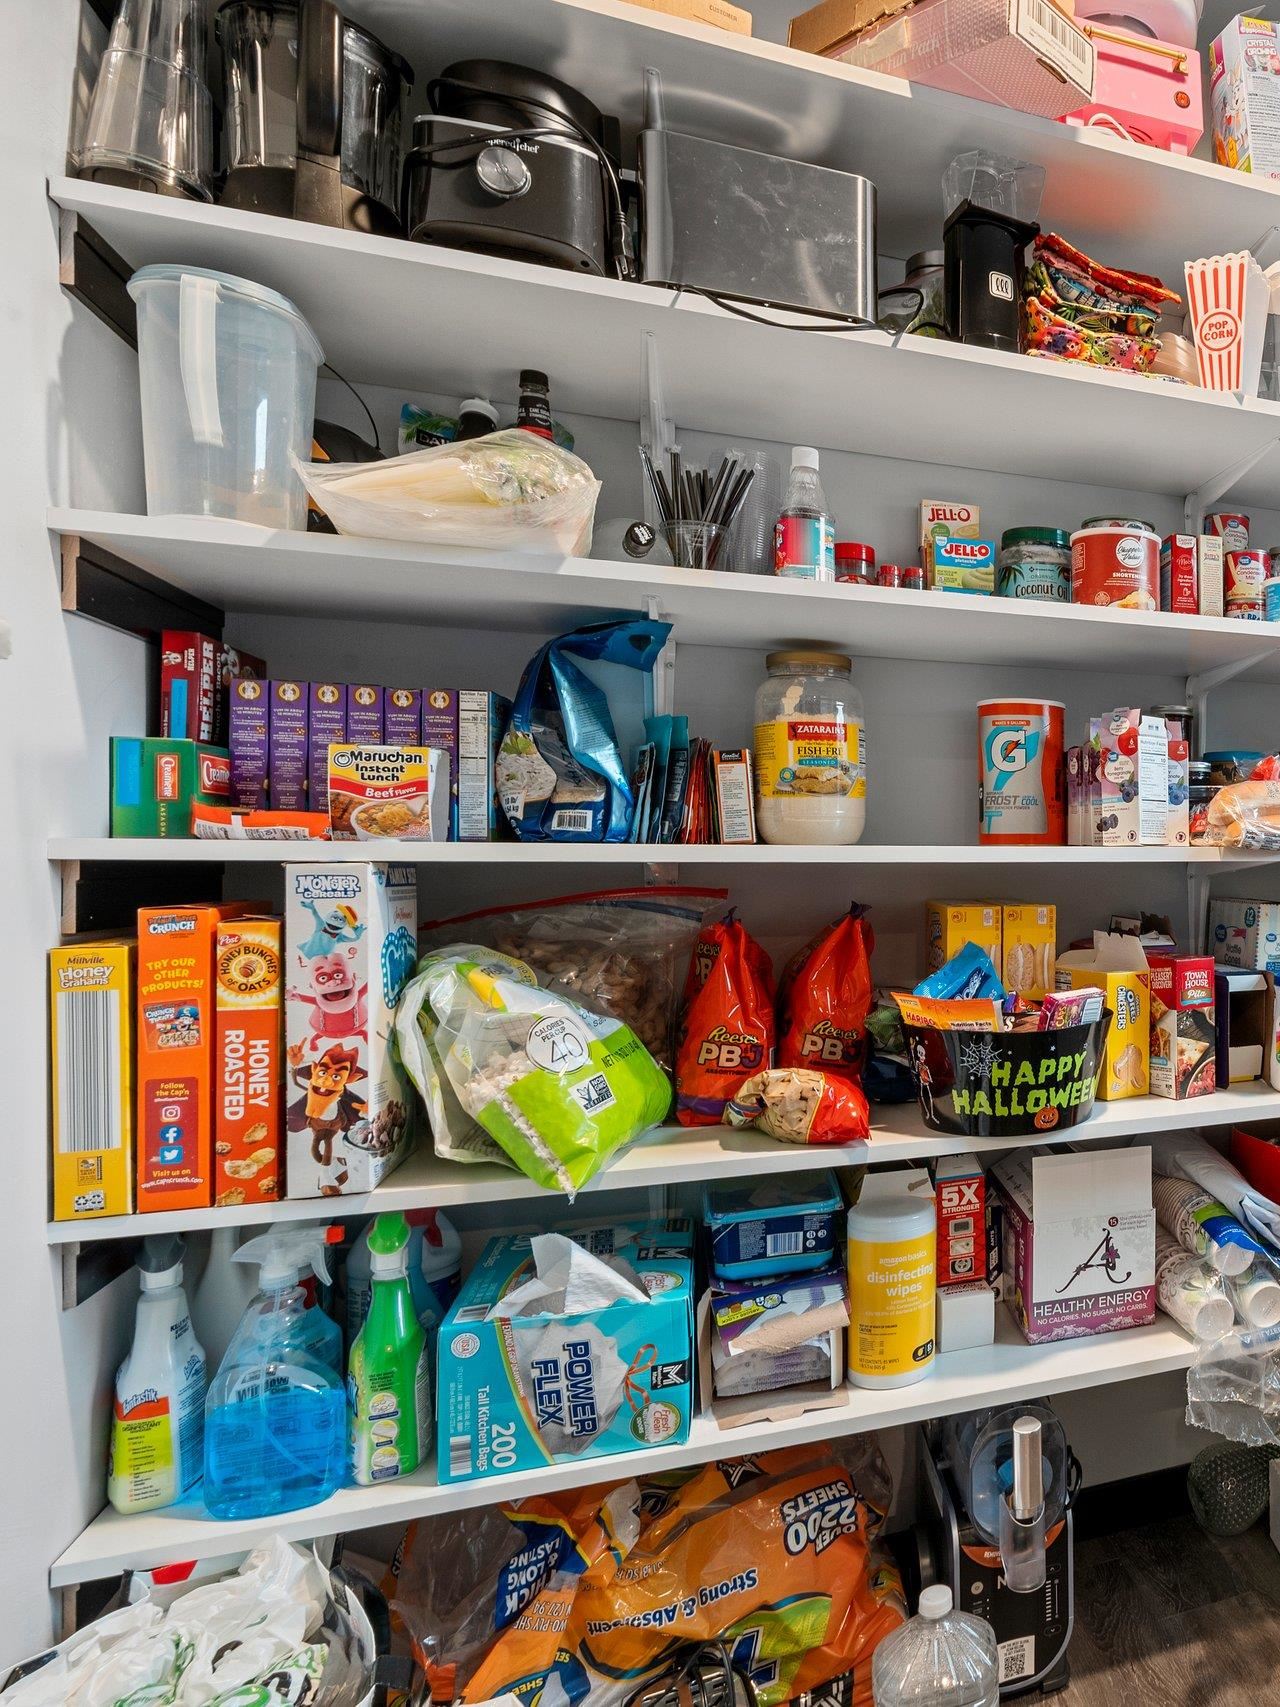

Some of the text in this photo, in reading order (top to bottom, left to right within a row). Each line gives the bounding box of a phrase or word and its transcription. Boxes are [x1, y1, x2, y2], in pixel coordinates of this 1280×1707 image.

[1208, 320, 1229, 332] POP
[1203, 329, 1234, 341] CORN
[927, 507, 971, 523] JELL-O
[943, 543, 991, 558] JELL-O
[1015, 582, 1069, 601] Coconut Oil
[200, 641, 214, 742] HELPER
[991, 729, 1028, 772] G
[1178, 744, 1184, 752] 6
[350, 751, 423, 764] Maruchan
[160, 756, 173, 798] Creamette
[355, 764, 405, 773] Instant
[360, 773, 400, 782] Lunch
[365, 786, 417, 798] Beef Flavor
[985, 796, 1040, 806] FROST COOL
[160, 803, 168, 837] LASAGNA
[1246, 907, 1254, 919] 12
[149, 920, 197, 935] CRUNCH
[219, 935, 240, 947] Post
[66, 955, 105, 966] Millville
[146, 957, 197, 972] TRY OUR
[221, 945, 277, 976] HONEY BUNCHES
[1223, 954, 1241, 966] Cones
[58, 965, 115, 981] Honey
[153, 968, 190, 982] OTHER
[1184, 970, 1208, 981] TOWN
[60, 976, 110, 989] Grahams
[141, 979, 205, 996] PRODUCTS!
[227, 977, 271, 992] of OATS
[1185, 979, 1209, 990] HOUSE
[1187, 989, 1206, 999] Pita
[145, 1007, 176, 1019] CRUNCH
[1117, 985, 1127, 1030] CAKESTERS
[905, 1011, 936, 1027] HARIBO
[534, 1018, 565, 1038] CALORIES
[541, 1026, 566, 1043] PER CUP
[708, 1026, 759, 1044] Reese's
[813, 1020, 858, 1040] Reese's
[551, 1031, 584, 1065] 40
[224, 1029, 246, 1121] ROASTED
[248, 1039, 270, 1108] HONEY
[991, 1050, 1088, 1087] HAPPY
[160, 1082, 185, 1090] Follow
[170, 1088, 190, 1098] Cap'n
[152, 1168, 192, 1178] Visit us on
[141, 1176, 204, 1190] www.capncrunch.com
[941, 1182, 980, 1208] 5X
[942, 1203, 981, 1215] STRONGER
[1109, 1217, 1118, 1226] 15
[867, 1263, 934, 1283] disinfecting
[886, 1281, 923, 1298] wipes
[1033, 1288, 1151, 1318] HEALTHY ENERGY
[1037, 1302, 1148, 1326] NO CALORIES. NO SUGAR. NO CARBS.
[460, 1338, 470, 1353] USA
[531, 1357, 565, 1428] FLEX
[564, 1339, 599, 1437] POWER
[476, 1385, 490, 1472] Tall Kitchen Bags
[652, 1409, 662, 1435] Clean
[661, 1408, 671, 1433] Fresh
[491, 1422, 517, 1469] 200
[782, 1481, 850, 1522] SHEETS
[786, 1499, 857, 1555] 2200
[815, 1523, 856, 1554] OVER
[509, 1537, 561, 1569] LASTING
[507, 1553, 558, 1590] & LONG
[697, 1567, 759, 1606] Strong
[682, 1598, 697, 1619] &
